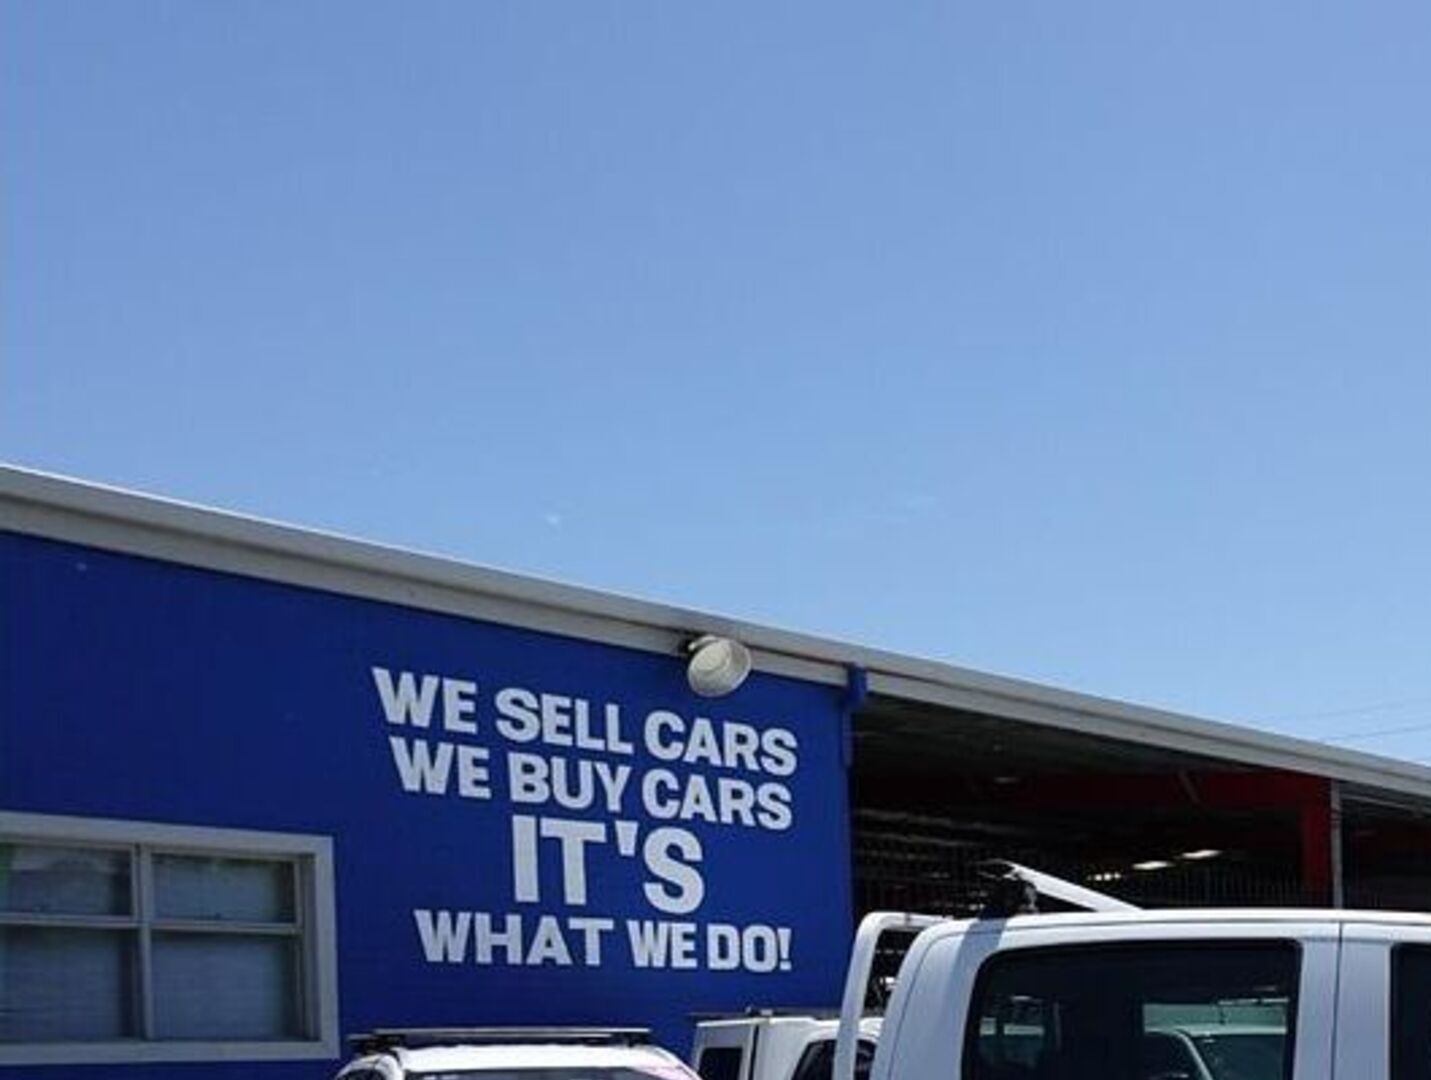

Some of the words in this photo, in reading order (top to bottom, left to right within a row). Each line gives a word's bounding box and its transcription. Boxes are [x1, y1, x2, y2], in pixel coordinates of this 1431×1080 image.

[372, 667, 477, 734] WE
[495, 688, 634, 754] SELL
[644, 711, 797, 776] CARS
[389, 736, 491, 799] WE
[508, 752, 631, 812] BUY
[642, 768, 792, 830] CARS
[512, 814, 704, 914] IT'S
[414, 909, 614, 966] WHAT
[626, 919, 698, 968] WE
[707, 923, 792, 972] DO!
